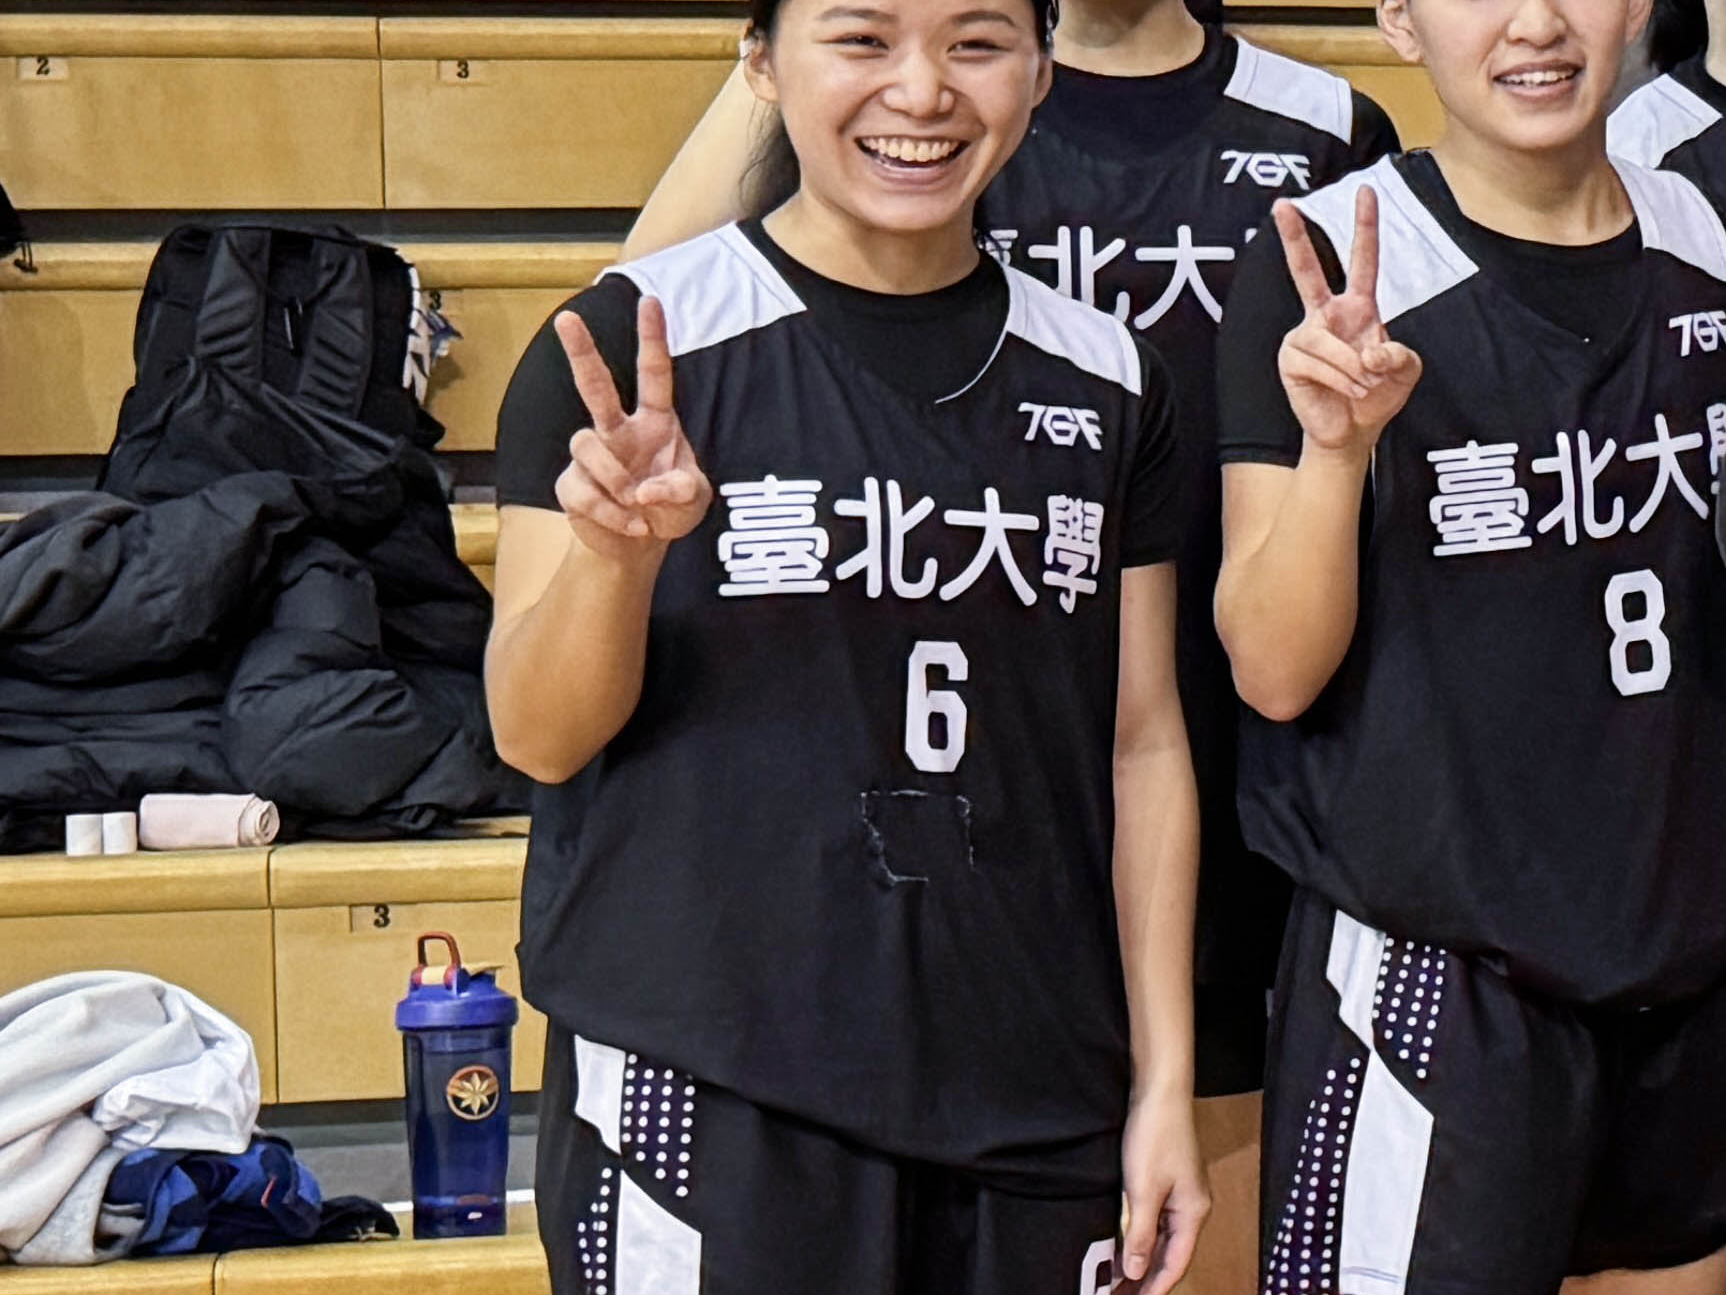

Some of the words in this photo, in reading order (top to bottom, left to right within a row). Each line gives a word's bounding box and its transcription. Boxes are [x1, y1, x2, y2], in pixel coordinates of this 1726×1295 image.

[37, 58, 50, 76] 2
[457, 61, 469, 79] 3
[429, 290, 442, 311] 3
[977, 225, 1258, 330] 北大
[718, 474, 1105, 614] 臺北大學
[1604, 568, 1672, 697] 8
[905, 640, 968, 773] 6
[373, 905, 390, 928] 3
